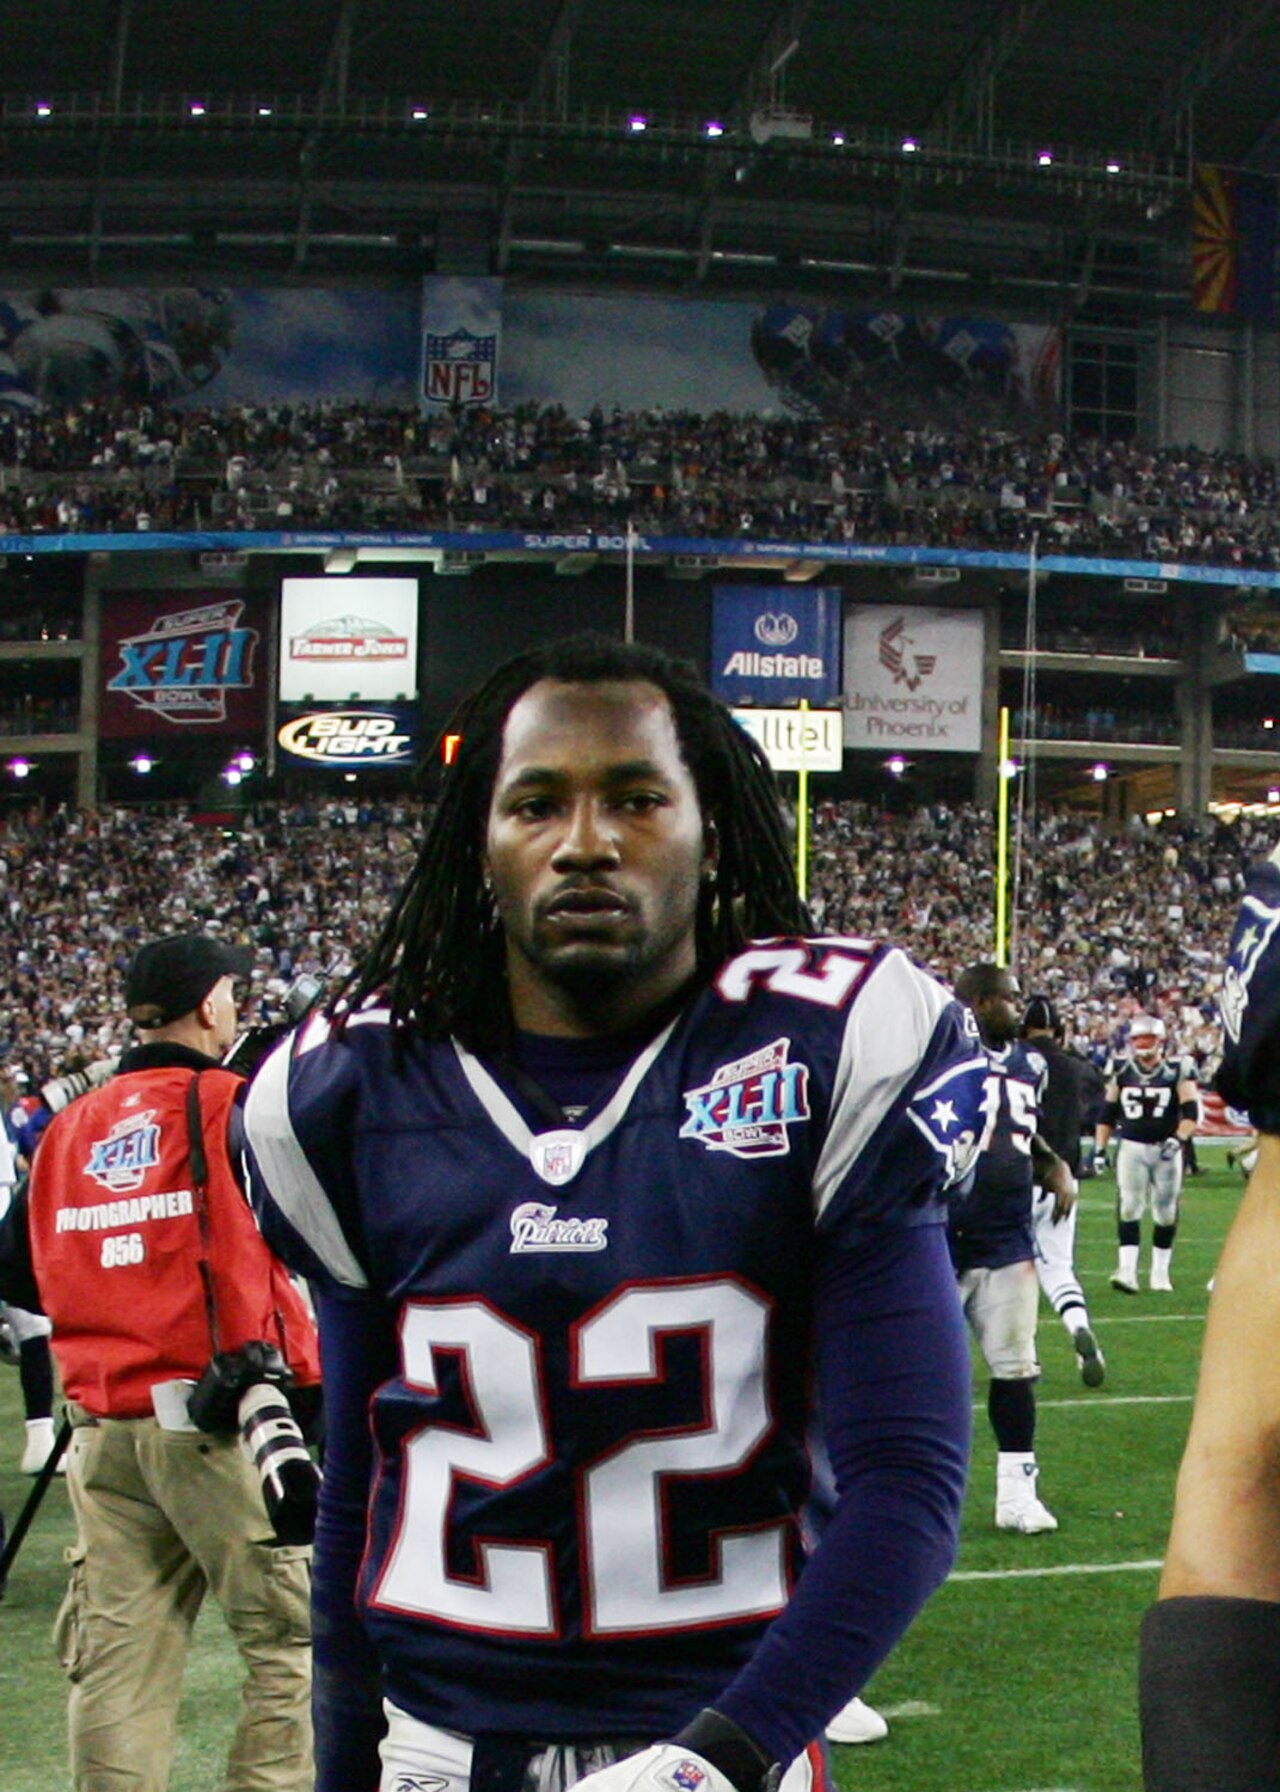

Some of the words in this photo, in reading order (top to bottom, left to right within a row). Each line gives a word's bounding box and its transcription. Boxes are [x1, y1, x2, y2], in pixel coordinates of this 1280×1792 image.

[428, 361, 491, 402] NFL
[523, 534, 590, 549] SUPER
[597, 535, 653, 551] BOWL
[723, 651, 824, 679] Allstate
[848, 691, 944, 718] University
[948, 695, 968, 715] of
[308, 718, 397, 737] BUD
[762, 716, 833, 751] lltel
[865, 714, 949, 738] Phoenix
[296, 735, 411, 755] LIGHT
[681, 1065, 807, 1133] XLII
[1120, 1086, 1172, 1120] 67
[101, 1232, 145, 1269] 856
[510, 1213, 609, 1254] Patriots
[368, 1270, 802, 1641] 22
